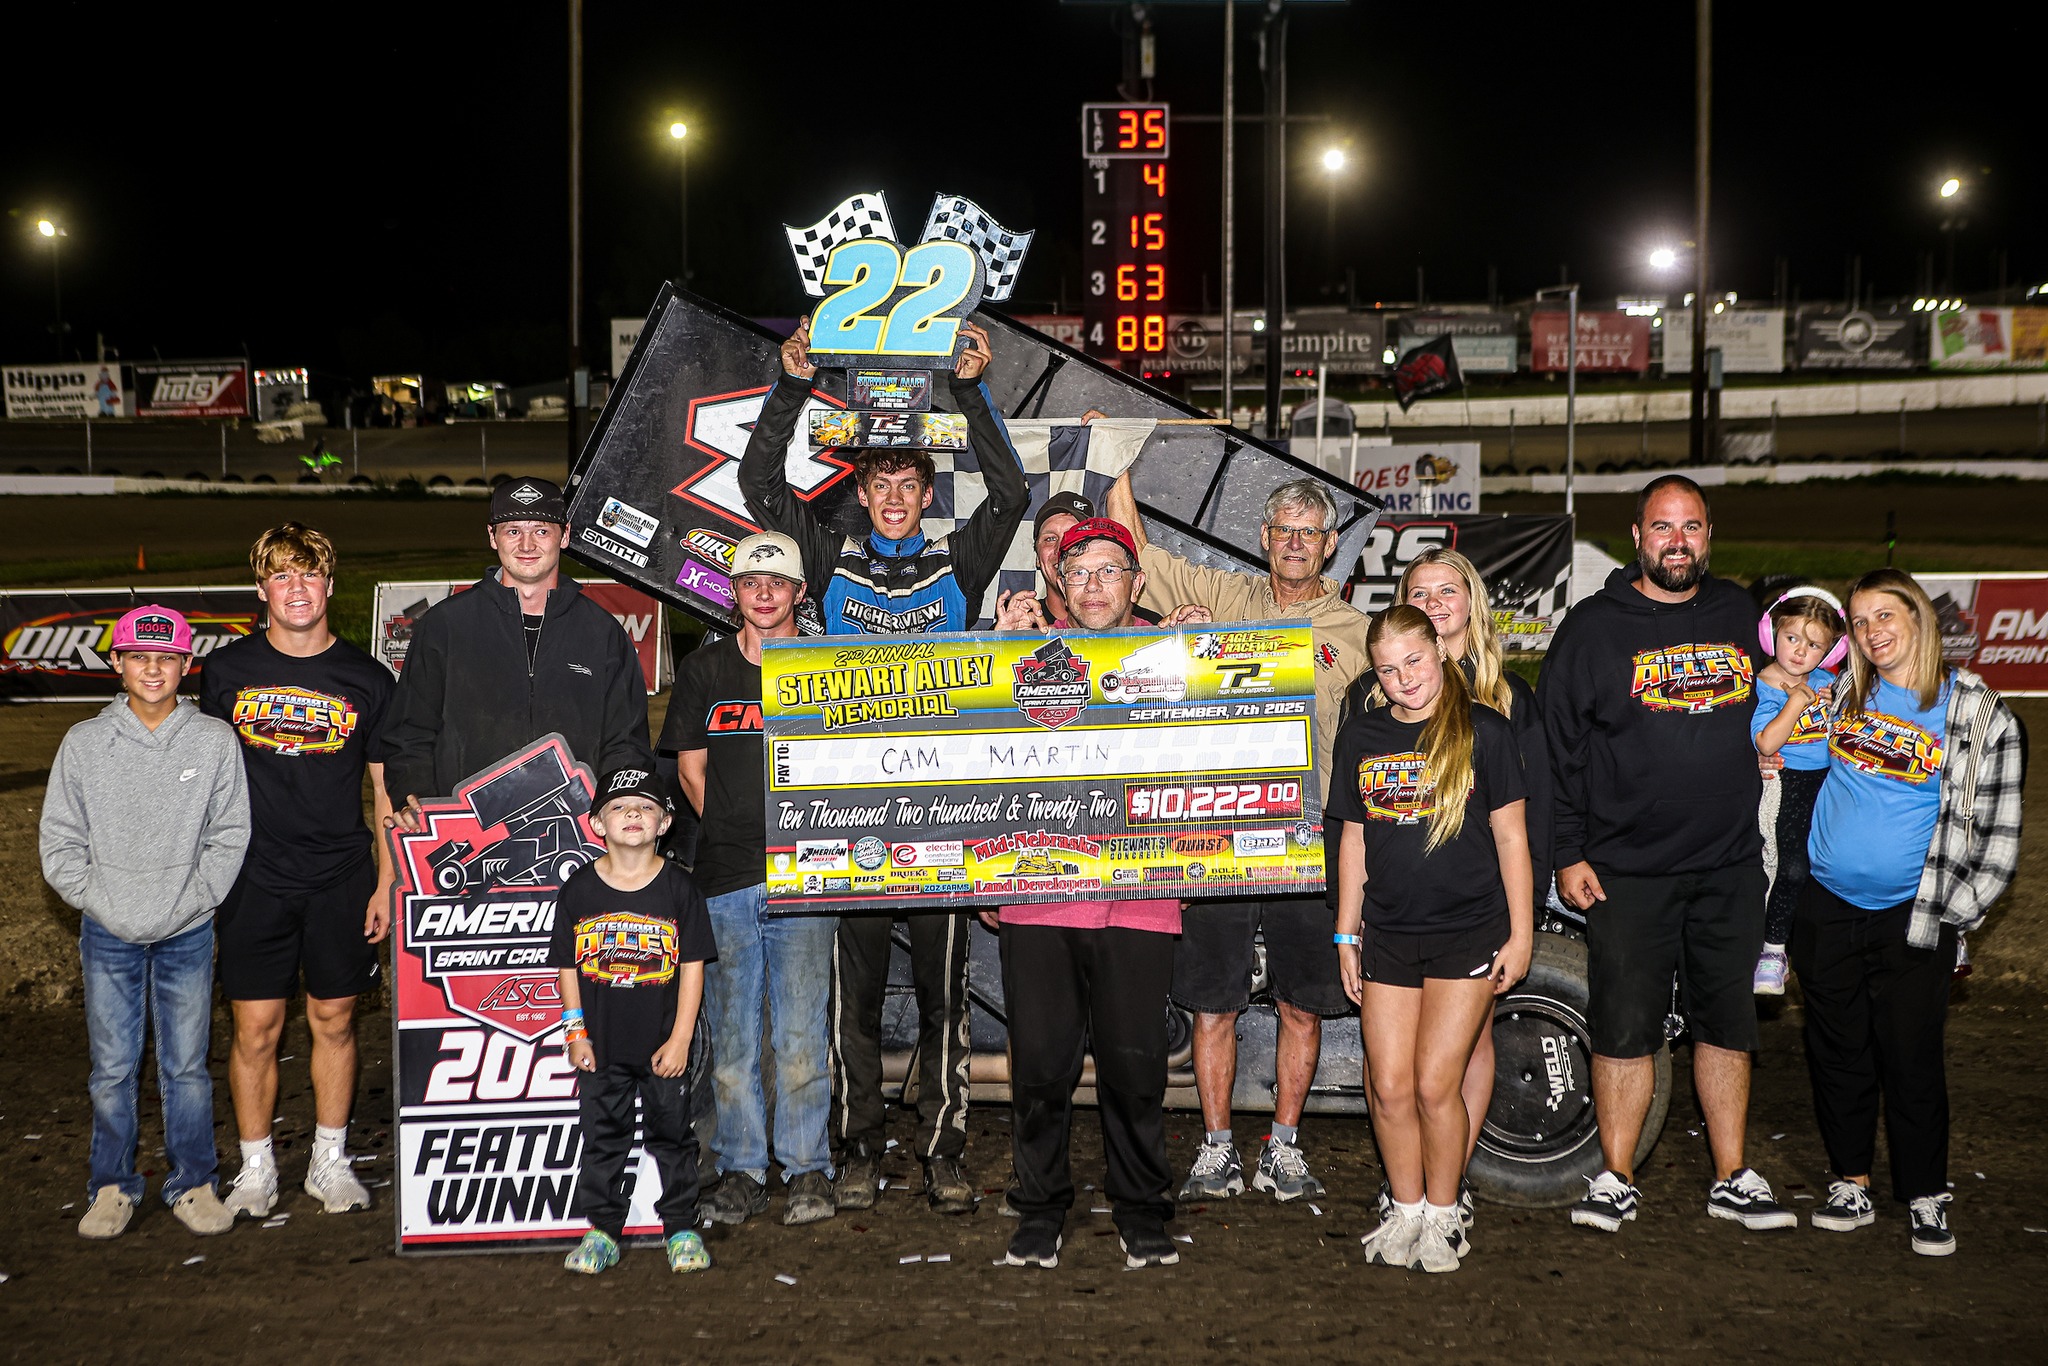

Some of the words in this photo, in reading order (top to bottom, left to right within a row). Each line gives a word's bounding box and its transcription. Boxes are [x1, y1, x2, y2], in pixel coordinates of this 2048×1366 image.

[1118, 110, 1166, 149] 35
[1094, 171, 1105, 194] 1
[1143, 164, 1165, 197] 4
[1091, 220, 1106, 245] 2
[1131, 213, 1165, 250] 15
[1091, 271, 1106, 295] 3
[1117, 265, 1165, 301] 63
[806, 239, 976, 356] 22
[1090, 323, 1104, 346] 4
[1117, 316, 1165, 351] 88
[1546, 334, 1633, 345] NERASKA
[1356, 464, 1411, 491] OE'S
[1381, 493, 1472, 511] ARING
[137, 623, 173, 634] HOOEY
[1219, 632, 1257, 644] EAGLE
[861, 642, 936, 665] ANNUAL
[1225, 640, 1281, 653] RACEWAY
[1655, 650, 1724, 664] STEWART
[779, 664, 908, 706] STEWART
[914, 656, 994, 692] ALLEY
[1103, 678, 1118, 688] MB
[1632, 656, 1753, 693] ALLEY
[1668, 672, 1724, 692] Memorial
[257, 693, 330, 709] STEWART
[1017, 684, 1087, 696] AMERICAN
[233, 700, 358, 737] ALLEY
[823, 695, 956, 729] MEMORIAL
[1128, 704, 1231, 721] SEPTEMBER,
[1234, 704, 1261, 717] 7th
[1265, 701, 1305, 714] 2025
[261, 715, 319, 732] Memorial
[881, 747, 940, 775] CAM
[990, 744, 1110, 768] MARTIN
[778, 765, 790, 783] PAY
[778, 800, 805, 831] Ten
[809, 798, 892, 830] Thousand
[895, 796, 924, 826] Two
[927, 793, 1004, 826] Hundred
[1005, 793, 1023, 822] &
[1026, 790, 1117, 829] Twenty-Two
[925, 843, 961, 852] electric
[890, 869, 928, 879] DRUEKE
[975, 879, 1013, 893] Land
[1017, 877, 1101, 893] Developers
[942, 883, 971, 891] FARMS
[595, 922, 661, 934] STEWART
[434, 948, 506, 968] SPRINT
[506, 950, 549, 967] CAR
[575, 932, 679, 964] ALLEY
[599, 943, 653, 962] Memorial
[424, 1029, 580, 1104] 202
[1541, 1036, 1566, 1097] WELD
[414, 1123, 582, 1177] FEATU
